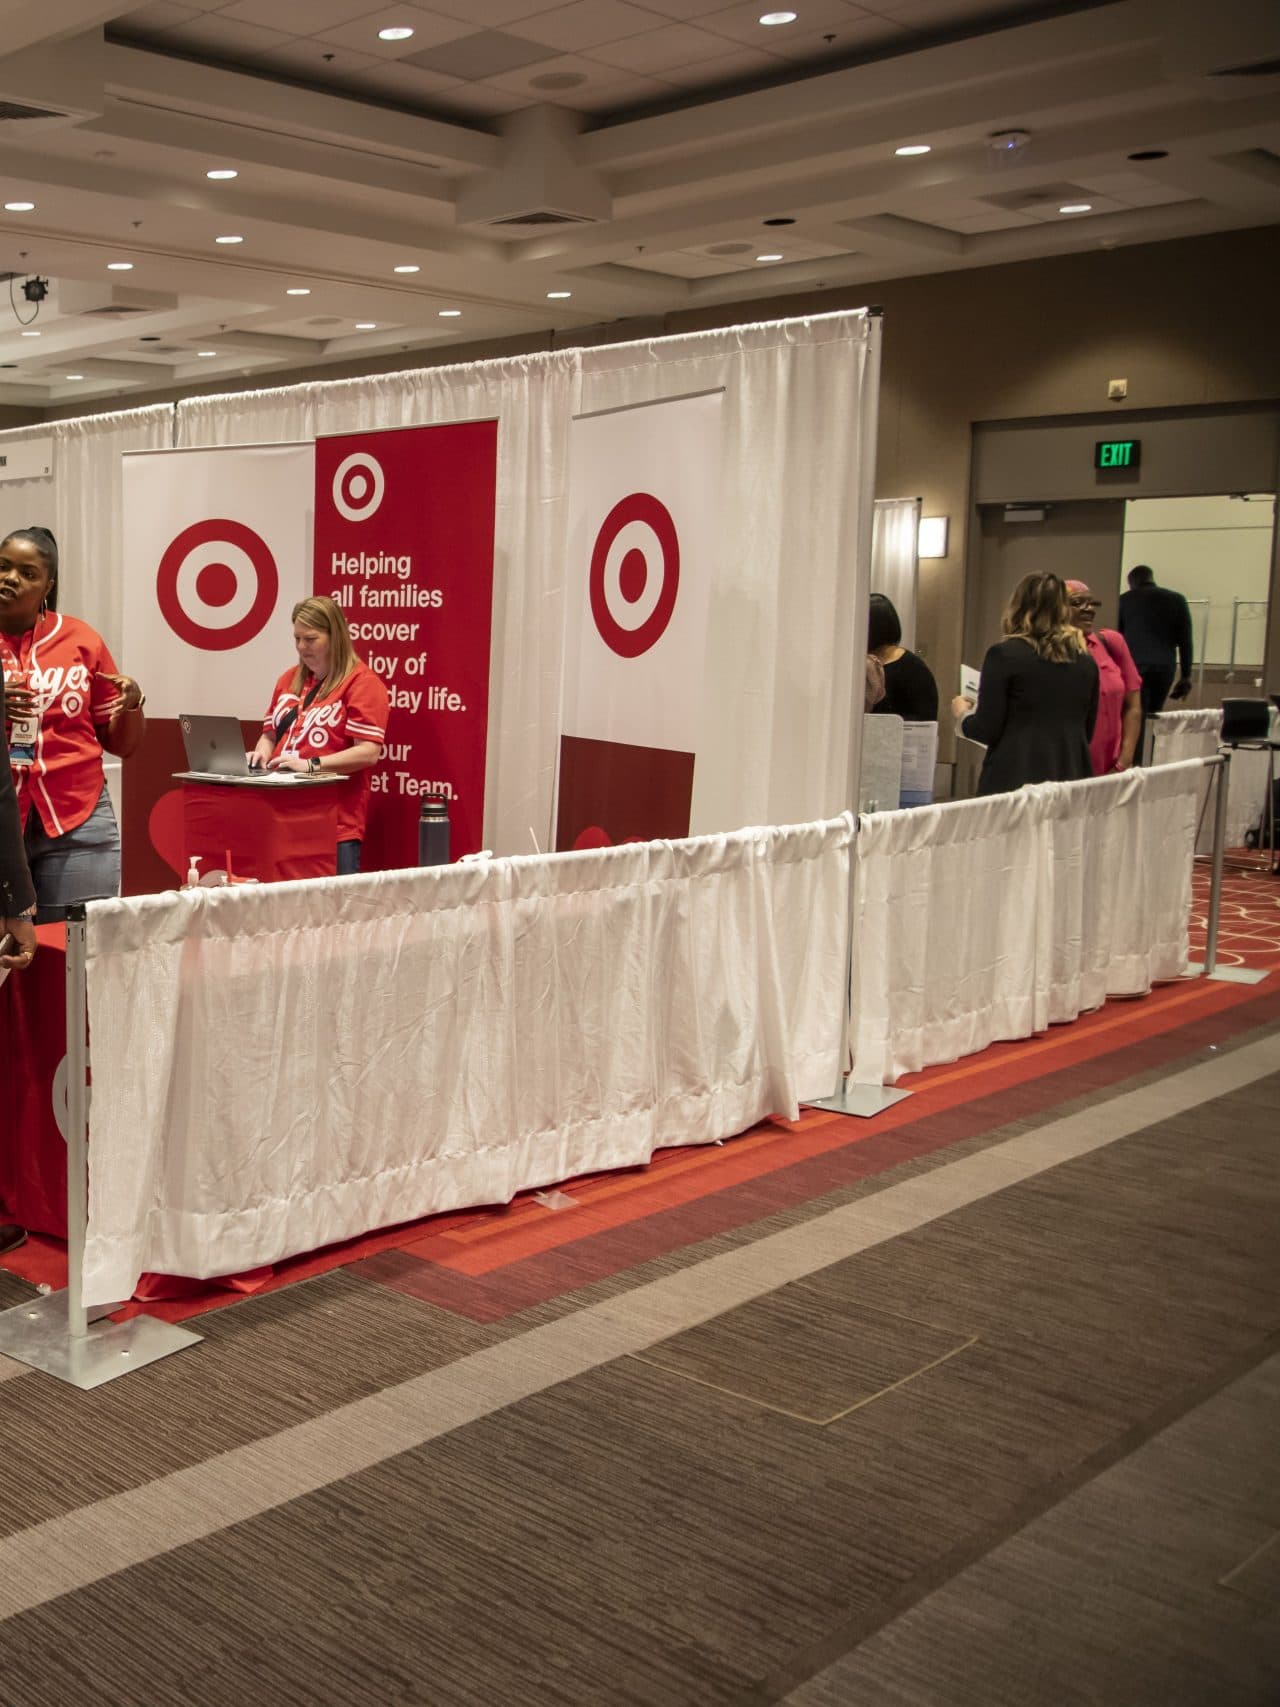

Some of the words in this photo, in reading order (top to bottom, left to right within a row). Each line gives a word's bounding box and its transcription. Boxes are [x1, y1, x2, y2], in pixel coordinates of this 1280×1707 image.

[1101, 443, 1133, 467] EXIT
[331, 550, 412, 580] Helping
[330, 584, 354, 608] all
[359, 584, 444, 608] families
[404, 652, 428, 676] of
[428, 686, 467, 712] life.
[395, 771, 459, 801] Team.
